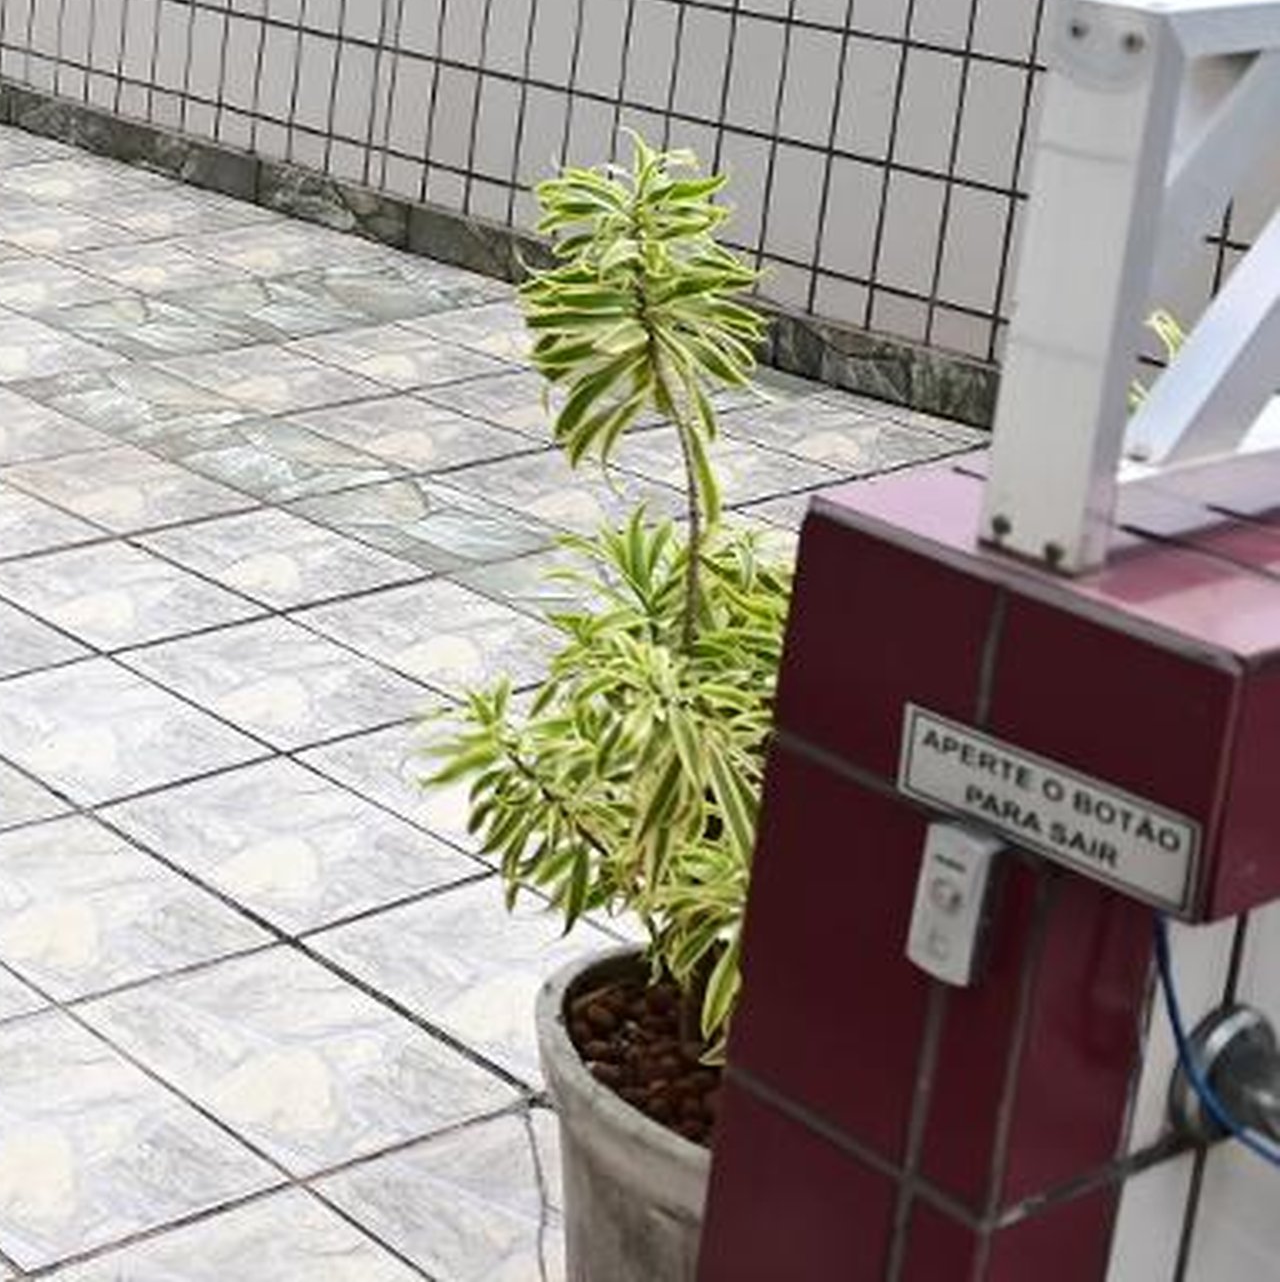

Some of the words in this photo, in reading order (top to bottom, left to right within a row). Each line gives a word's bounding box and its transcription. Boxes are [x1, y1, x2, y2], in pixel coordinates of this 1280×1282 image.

[922, 728, 1031, 788] APERTE
[1042, 778, 1065, 802] O
[965, 784, 1043, 833] PARA
[1050, 823, 1119, 867] SAIR
